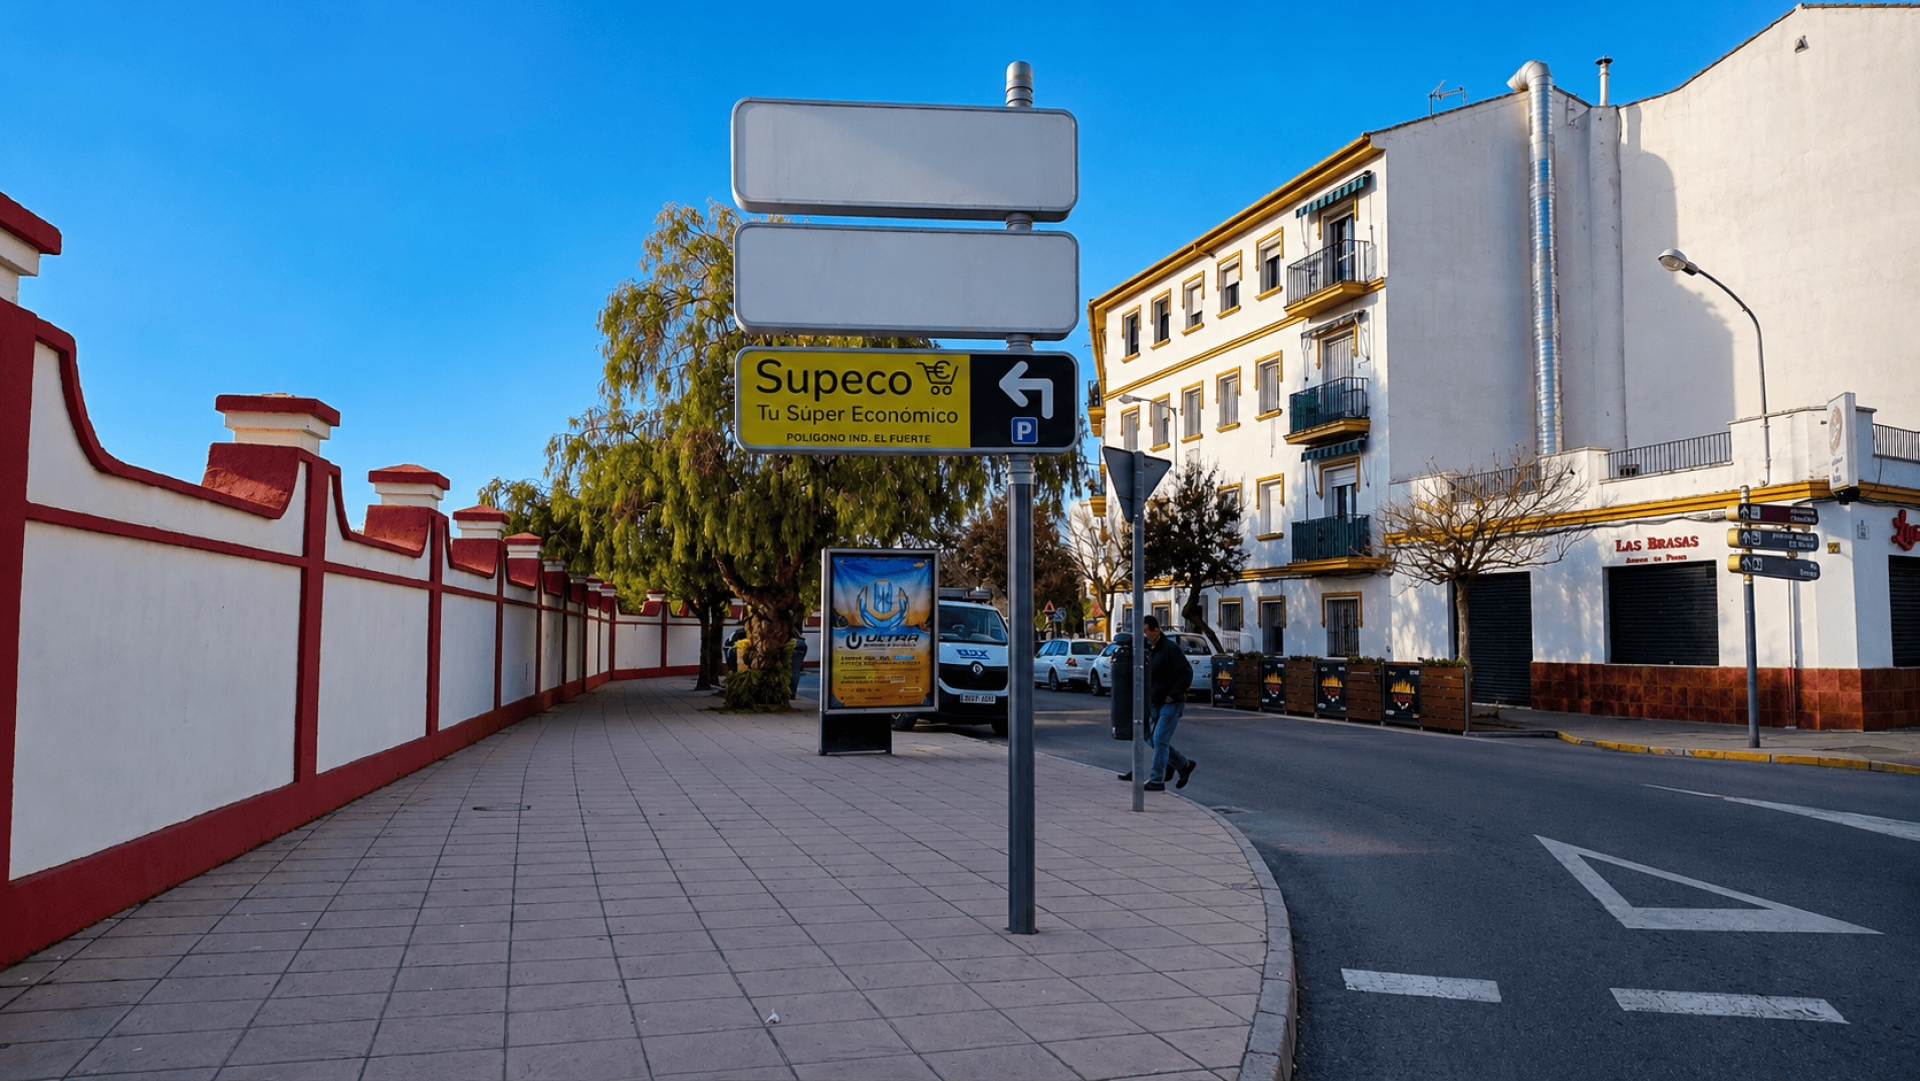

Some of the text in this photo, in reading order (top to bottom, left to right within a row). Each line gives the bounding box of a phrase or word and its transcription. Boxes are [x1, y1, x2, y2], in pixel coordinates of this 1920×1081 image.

[756, 358, 912, 402] Supeco
[756, 404, 958, 425] Tu Súper Económico
[849, 433, 871, 443] IND.
[874, 434, 887, 443] EL
[890, 434, 931, 443] FUERTE
[1017, 421, 1032, 441] P
[1615, 536, 1699, 552] LAS BRASAS
